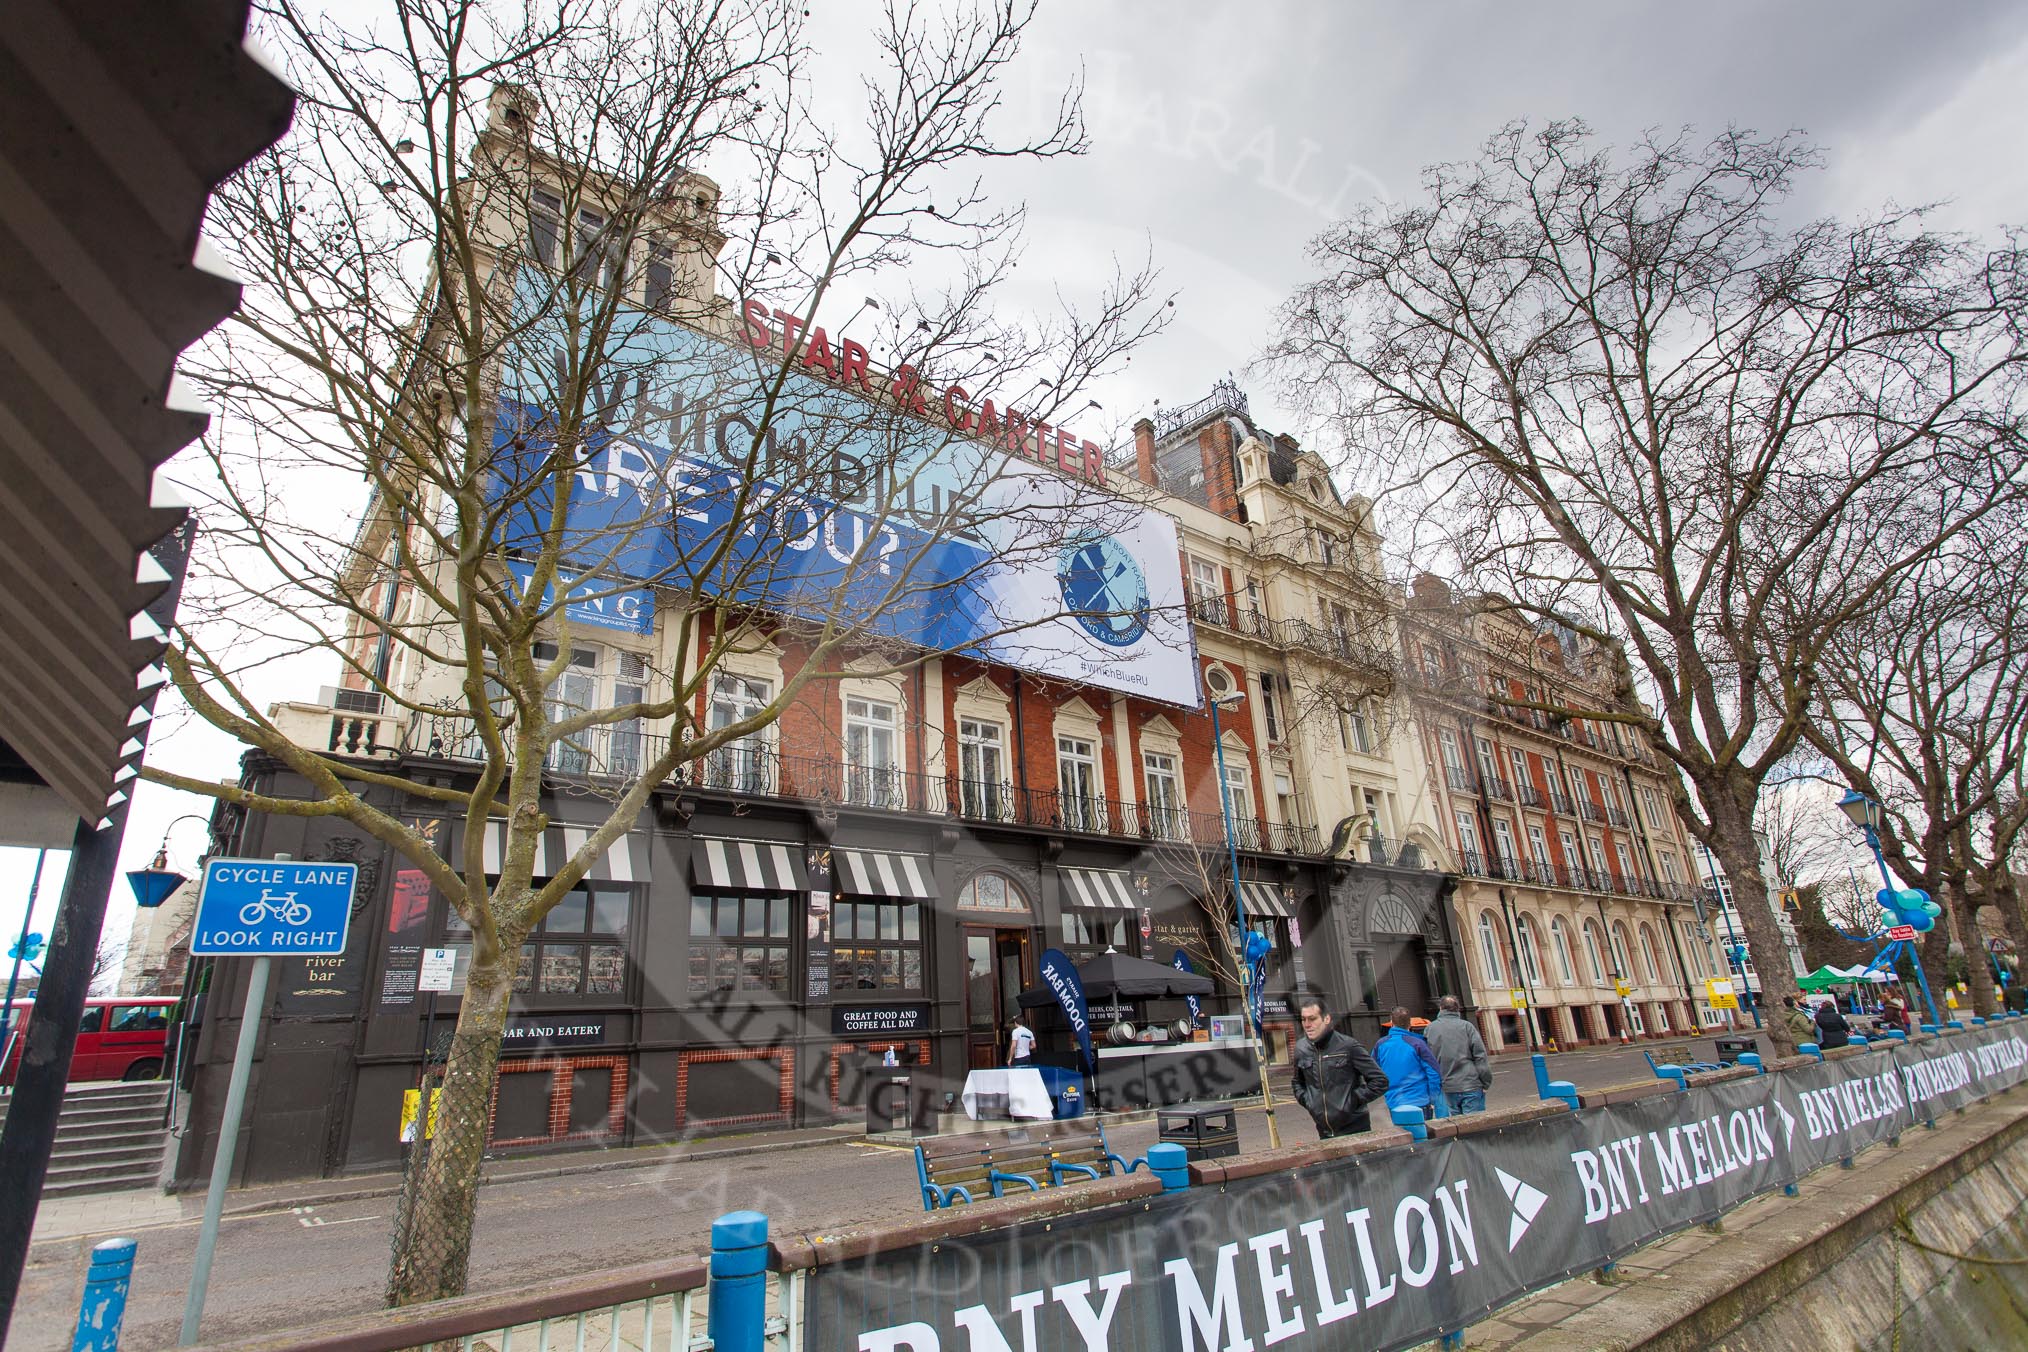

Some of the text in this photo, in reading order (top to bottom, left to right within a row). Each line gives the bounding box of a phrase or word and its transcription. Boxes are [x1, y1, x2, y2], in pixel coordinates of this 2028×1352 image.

[737, 299, 1107, 486] STAR & GARTER
[831, 450, 978, 542] BLUE
[537, 440, 899, 575] ARE YOU?
[1113, 544, 1132, 564] BOAT
[1069, 597, 1099, 634] OXORD
[1100, 631, 1106, 639] &
[1081, 662, 1148, 685] #WhichBlueRU
[215, 868, 348, 885] CYCLE LANE
[202, 931, 337, 946] LOOK RIGHT
[306, 956, 345, 967] river
[309, 970, 335, 981] bar
[844, 1010, 917, 1021] GREAT FOOD AND
[846, 1019, 915, 1030] COFFEE ALL DAY
[527, 1027, 553, 1037] AND
[558, 1025, 602, 1036] EATERY
[1799, 1086, 1848, 1140] BNY
[1571, 1105, 1774, 1224] BNY MELLON
[1164, 1179, 1479, 1352] MELLON
